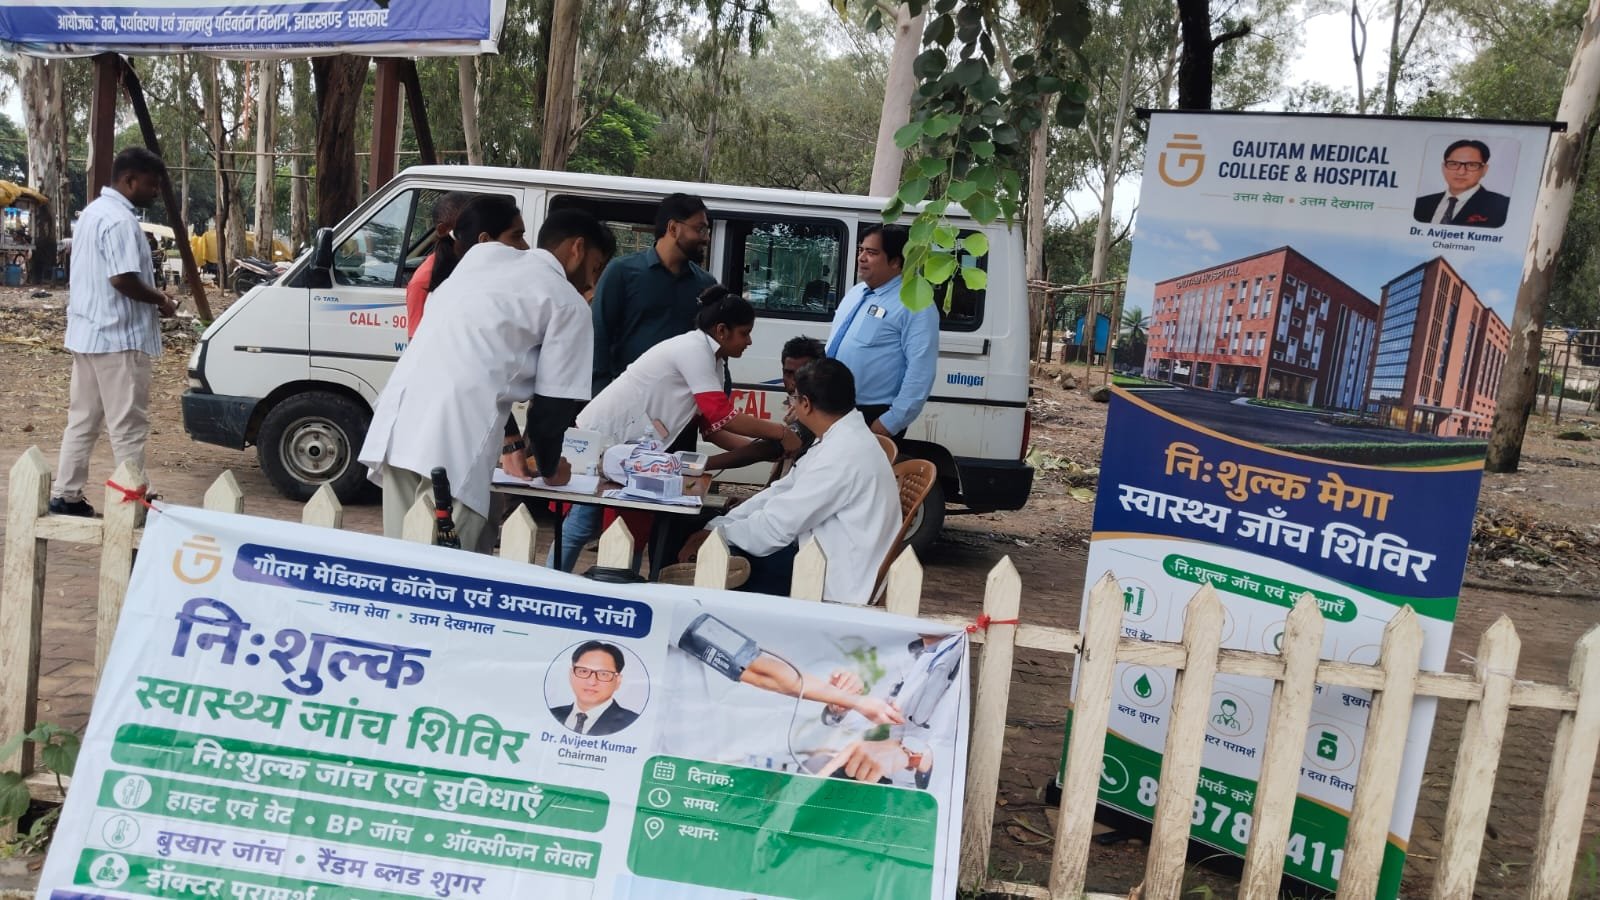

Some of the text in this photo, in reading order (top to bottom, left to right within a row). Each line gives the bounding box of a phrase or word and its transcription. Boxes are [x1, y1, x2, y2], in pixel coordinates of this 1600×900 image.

[101, 14, 118, 34] वन,
[120, 11, 158, 32] पर्यावरण
[161, 12, 176, 32] एवं
[177, 15, 215, 37] जलवायु
[215, 10, 254, 32] परिवर्तन
[256, 10, 291, 33] विभाग,
[293, 11, 343, 31] झारखण्ड
[347, 9, 390, 29] सरकार
[1232, 140, 1390, 165] GAUTAM MEDICAL
[1218, 161, 1399, 188] COLLEGE & HOSPITAL
[1233, 191, 1375, 211] उत्तम सेवा उत्तम देखभाल
[1409, 226, 1504, 243] Dr. Avijeet Kumar
[1432, 241, 1476, 252] Chairman
[349, 311, 381, 327] CALL
[946, 371, 986, 387] winger
[729, 390, 772, 420] CAL
[1317, 471, 1394, 521] मेगा
[1118, 483, 1436, 583] स्वास्थ्य जाँच शिविर
[253, 553, 637, 629] गौतम मेडिकल कॉलेज एवं अस्पताल, रांची
[1264, 585, 1285, 600] एवं
[329, 600, 496, 635] उत्तम सेवा उत्तम देखभाल
[135, 676, 530, 764] स्वास्थ्य जांच शिविर
[1118, 703, 1160, 725] ब्लड शुगर
[540, 731, 638, 755] Dr. Avijeet Kumar
[1223, 740, 1256, 758] परामर्श
[557, 748, 608, 764] Chairman
[687, 766, 735, 788] दिनांक:
[1308, 769, 1327, 783] दवा
[315, 761, 378, 791] जांच
[384, 770, 428, 800] एवं
[433, 777, 545, 819] सुविधाएँ
[682, 796, 720, 812] समय:
[165, 790, 594, 870] हाइट एवं वेट BP जांच ऑक्सीजन लेवल
[678, 823, 720, 841] स्थान:
[156, 830, 486, 898] बुखार जांच रैंडम ब्लड शुगर
[145, 864, 226, 897] डॉक्टर
